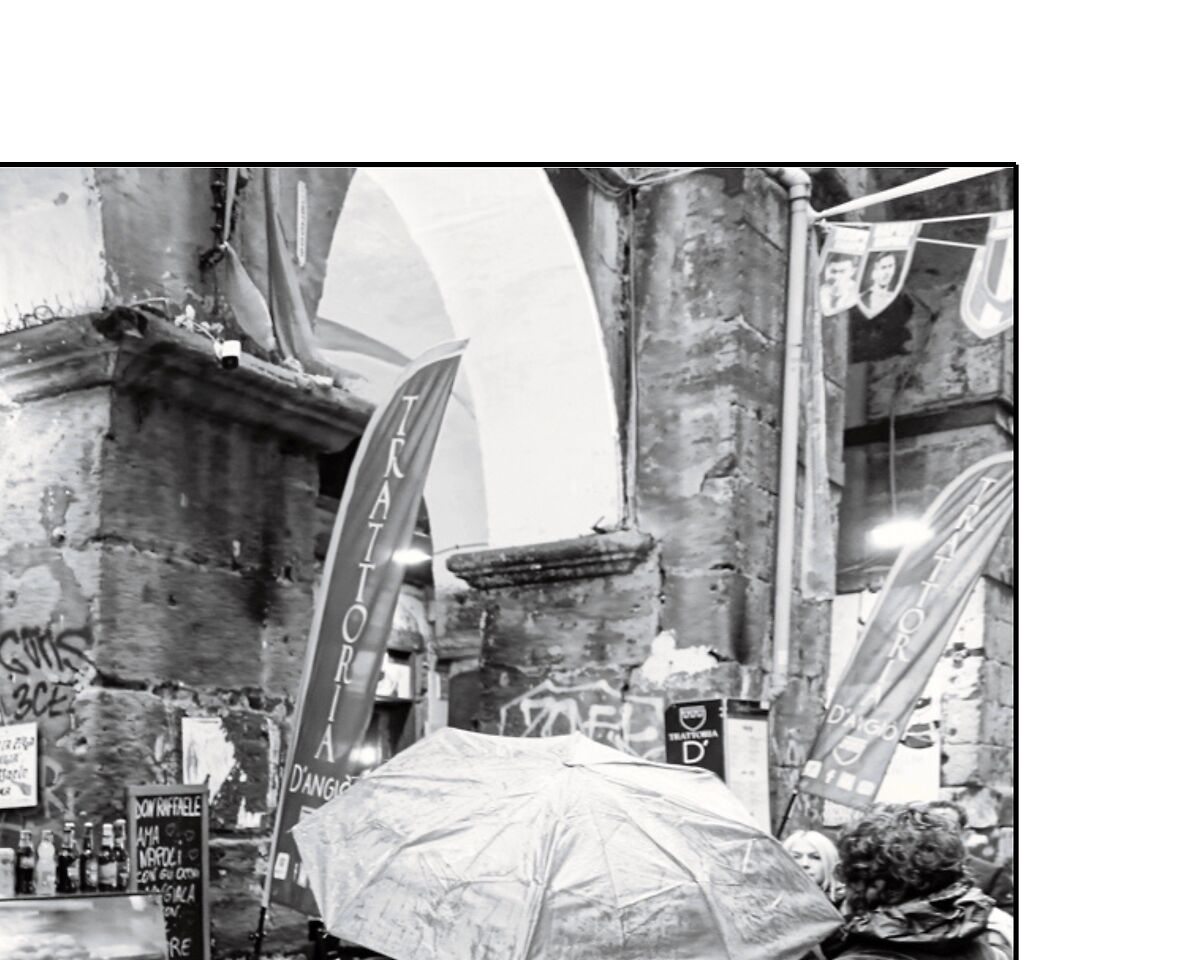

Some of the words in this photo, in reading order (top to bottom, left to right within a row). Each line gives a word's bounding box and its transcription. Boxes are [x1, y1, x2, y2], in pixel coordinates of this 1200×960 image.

[314, 395, 419, 763] TRATTORIA
[668, 730, 719, 742] TRATTORIA
[137, 825, 160, 848] AMA
